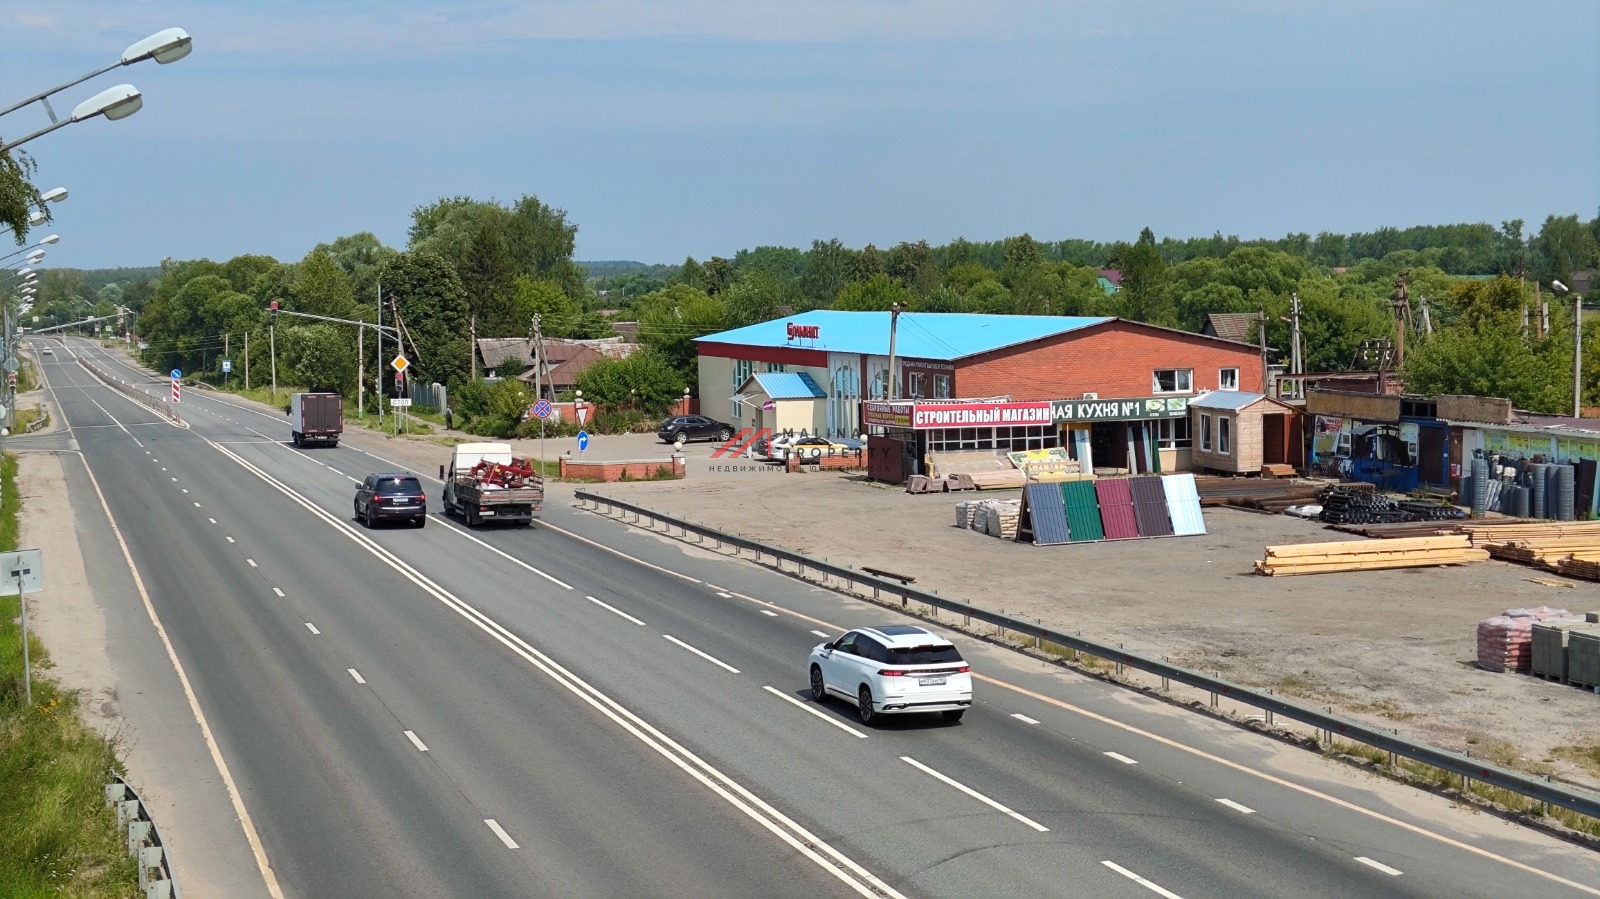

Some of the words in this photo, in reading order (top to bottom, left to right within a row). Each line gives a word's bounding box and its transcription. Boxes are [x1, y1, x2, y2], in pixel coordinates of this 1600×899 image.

[892, 405, 910, 414] РАБОТЫ
[916, 406, 1001, 424] СТРОИТЕЛЬНЫЙ
[1002, 407, 1050, 421] МАГАЗИН
[1077, 402, 1119, 418] КУХНЯ
[1121, 401, 1140, 416] №1
